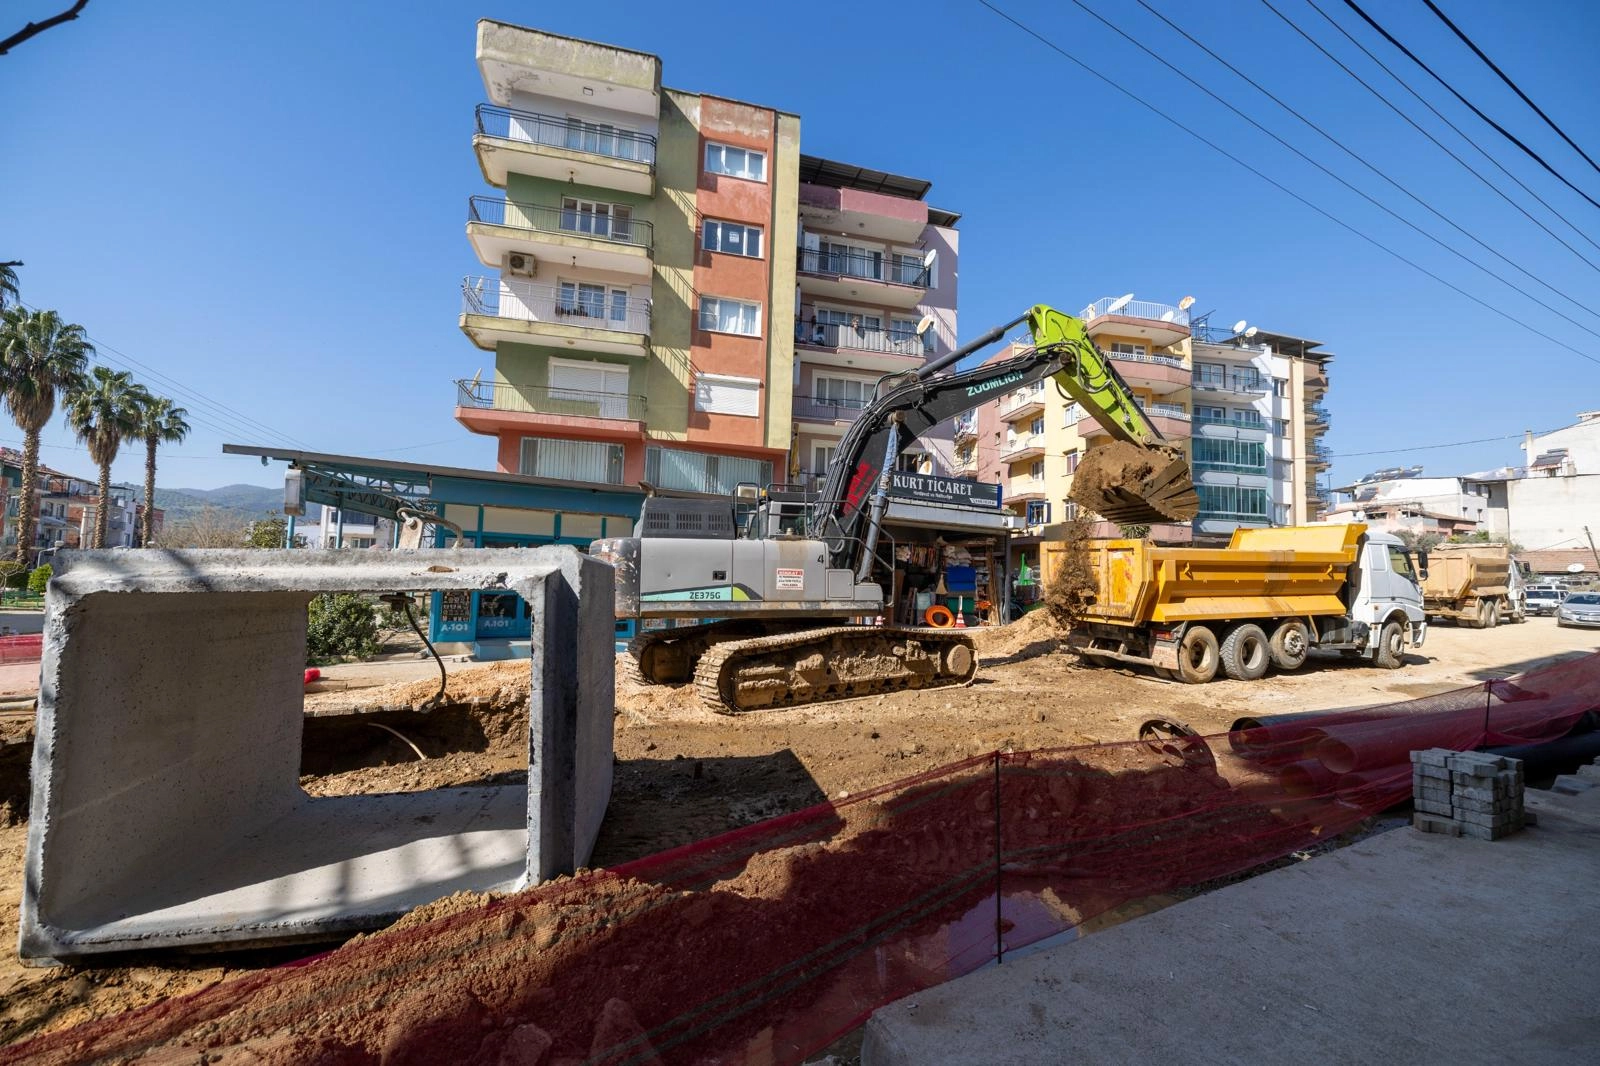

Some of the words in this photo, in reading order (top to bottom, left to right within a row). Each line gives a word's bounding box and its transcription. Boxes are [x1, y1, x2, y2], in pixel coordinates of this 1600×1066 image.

[965, 370, 1024, 397] ZOOMLION
[893, 474, 924, 490] KURT
[927, 477, 973, 496] TİCARET
[817, 554, 824, 564] 4
[690, 591, 721, 600] ZE375G
